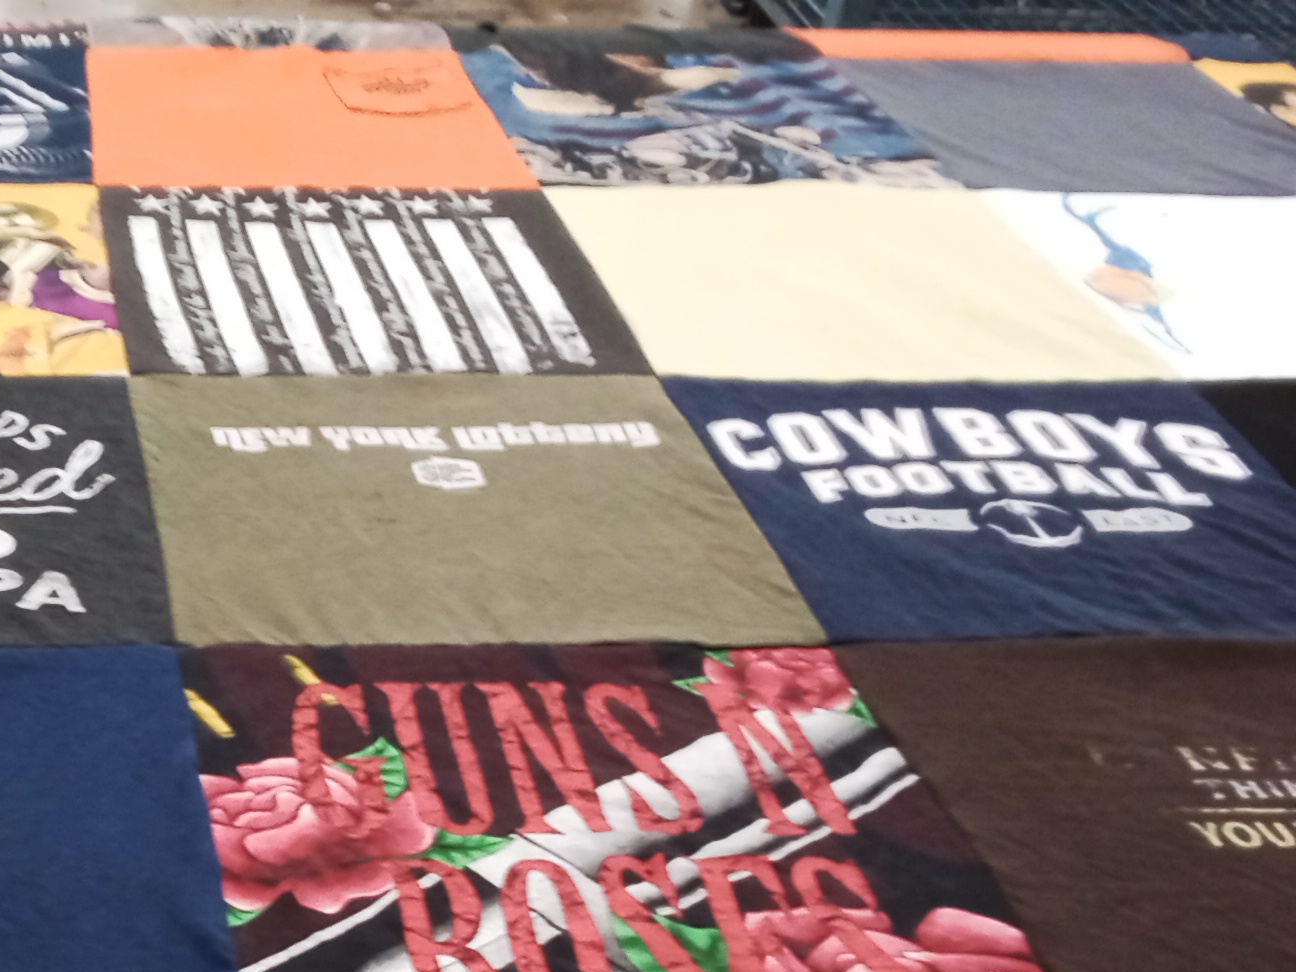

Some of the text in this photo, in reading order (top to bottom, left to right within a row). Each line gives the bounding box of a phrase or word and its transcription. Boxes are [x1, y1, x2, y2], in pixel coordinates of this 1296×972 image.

[706, 407, 1253, 480] COWBOYS
[801, 460, 1214, 507] FOOTBALL
[289, 680, 704, 837] GUNS
[1188, 820, 1296, 848] YOU
